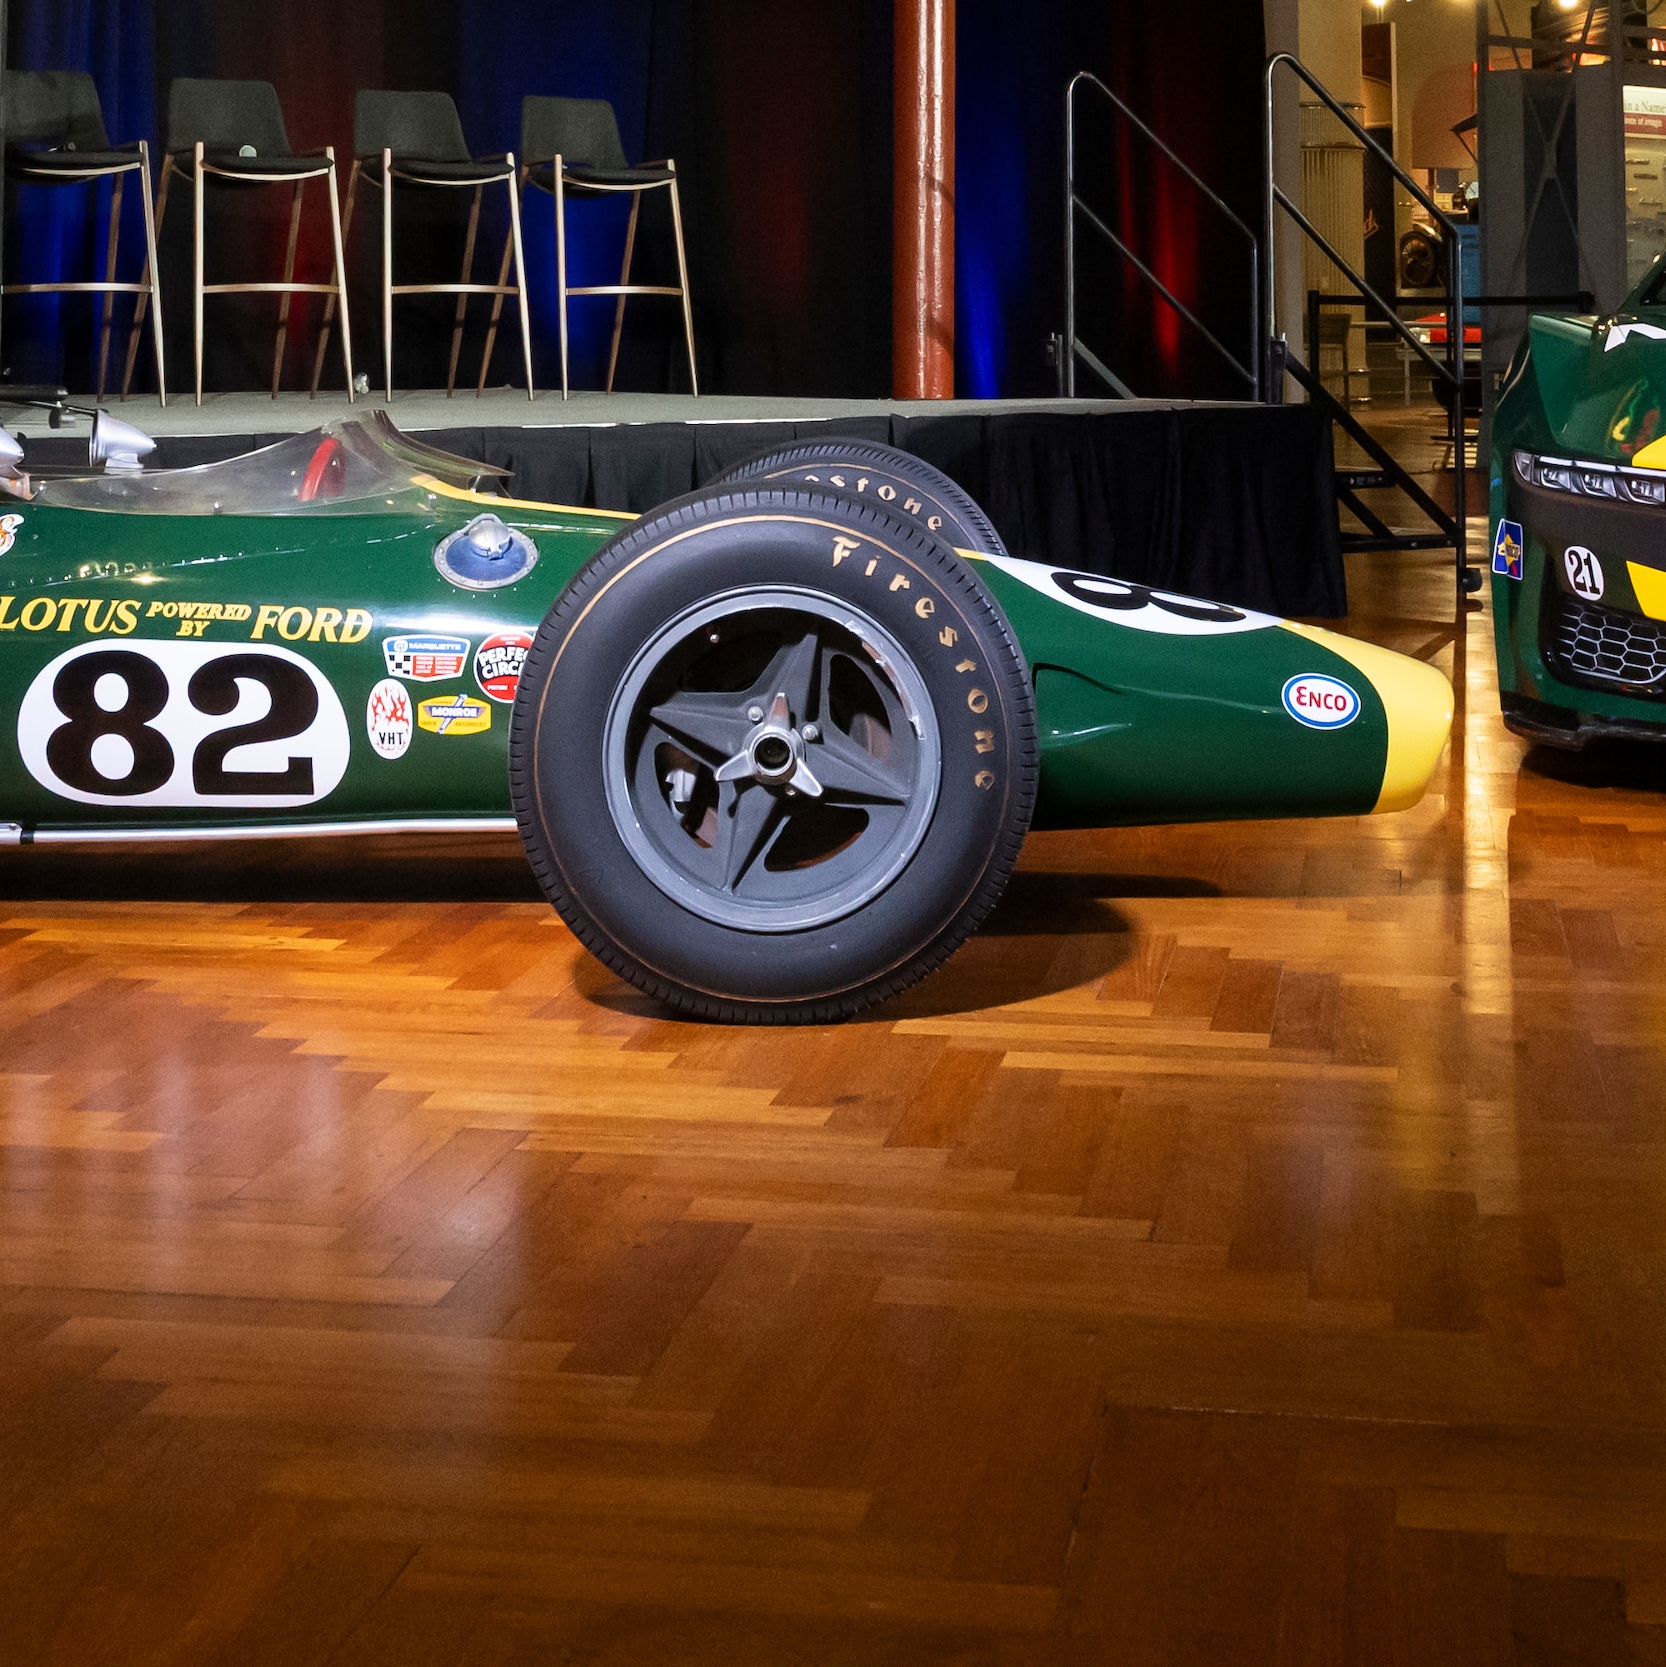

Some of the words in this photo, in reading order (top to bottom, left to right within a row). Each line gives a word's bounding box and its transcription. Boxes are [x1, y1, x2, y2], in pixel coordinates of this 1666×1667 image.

[1568, 550, 1600, 595] 21
[146, 601, 252, 621] POWERED
[176, 620, 211, 637] BY
[250, 605, 374, 643] FORD
[409, 643, 461, 651] MARQUETTE
[832, 536, 995, 791] Firestone
[1295, 686, 1347, 712] ENCO
[46, 650, 319, 796] 82
[431, 707, 480, 717] MONROE
[379, 732, 403, 745] VHT
